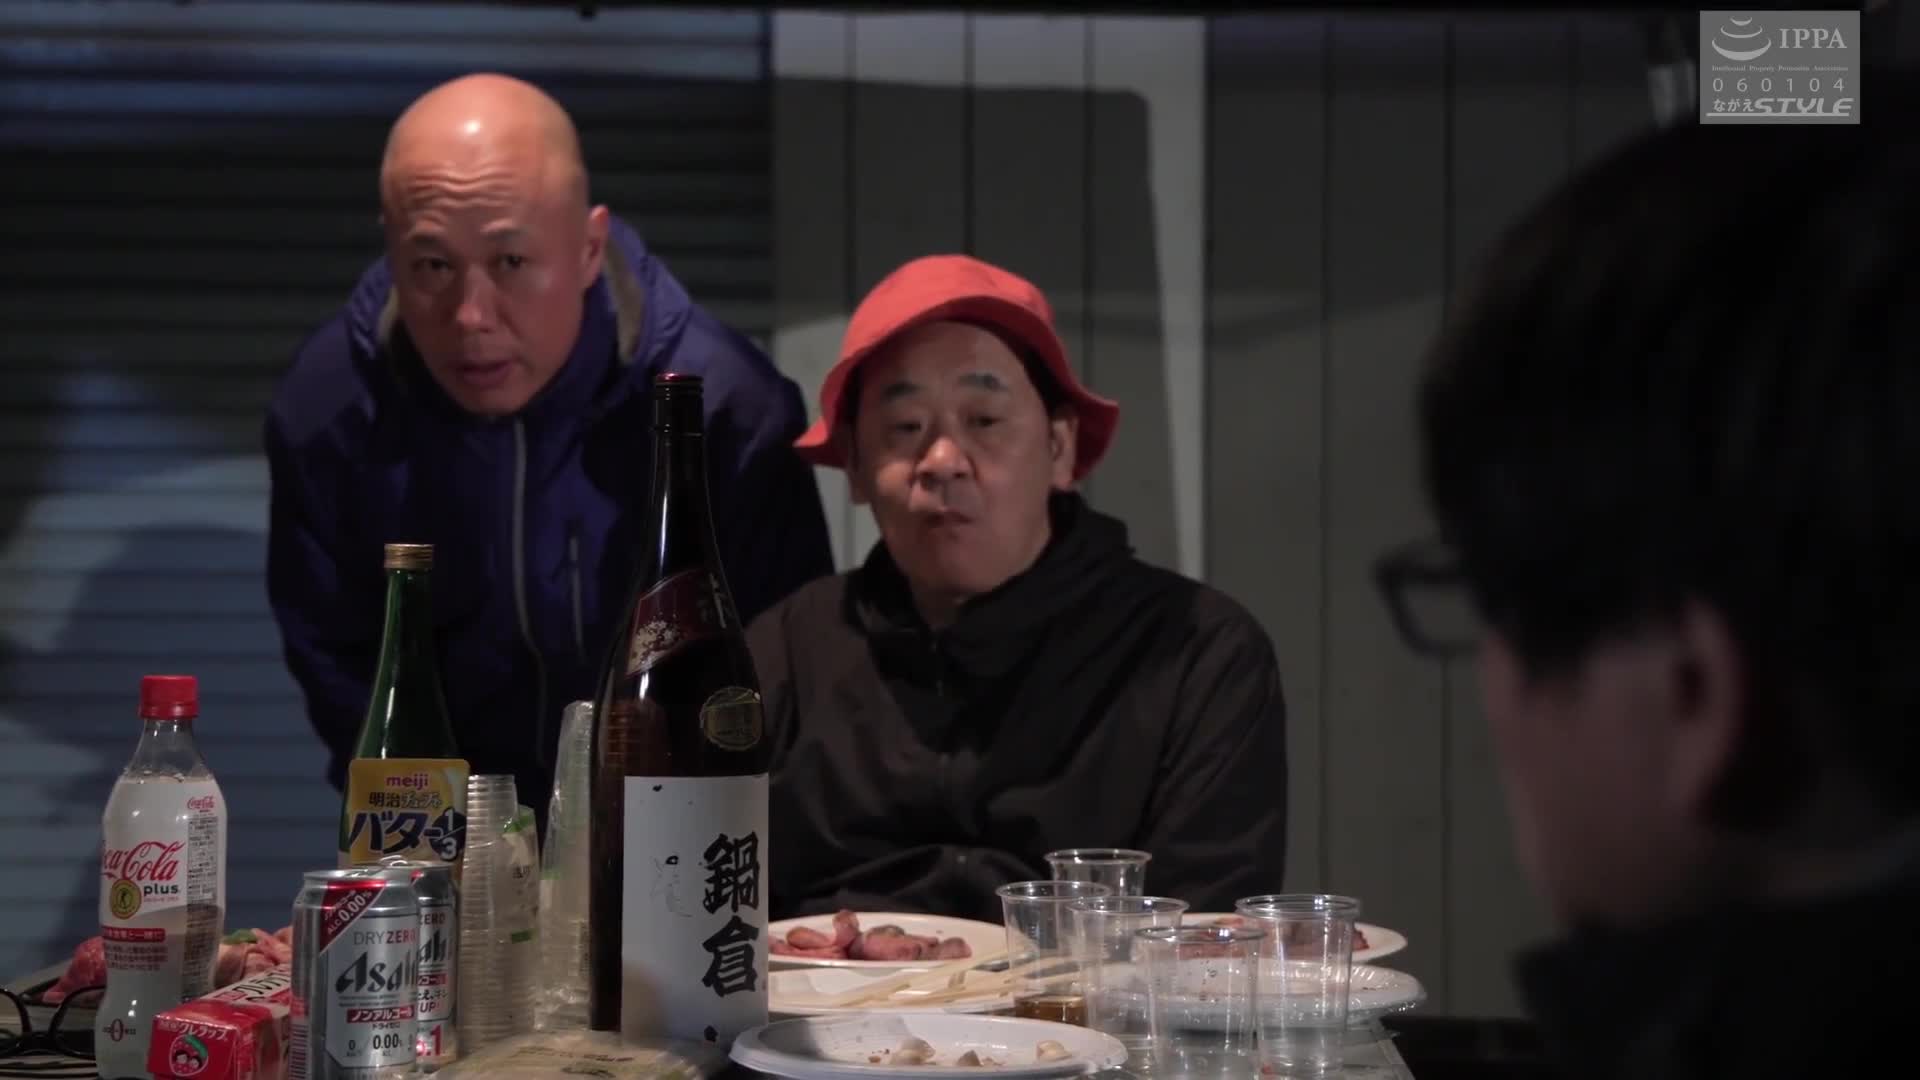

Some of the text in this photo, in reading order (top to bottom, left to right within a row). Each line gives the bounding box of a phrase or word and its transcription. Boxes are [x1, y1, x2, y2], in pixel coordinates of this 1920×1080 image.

[386, 773, 429, 790] meiji
[102, 841, 186, 881] ca-Cola
[143, 883, 179, 897] plus
[702, 831, 760, 998] 鍋倉
